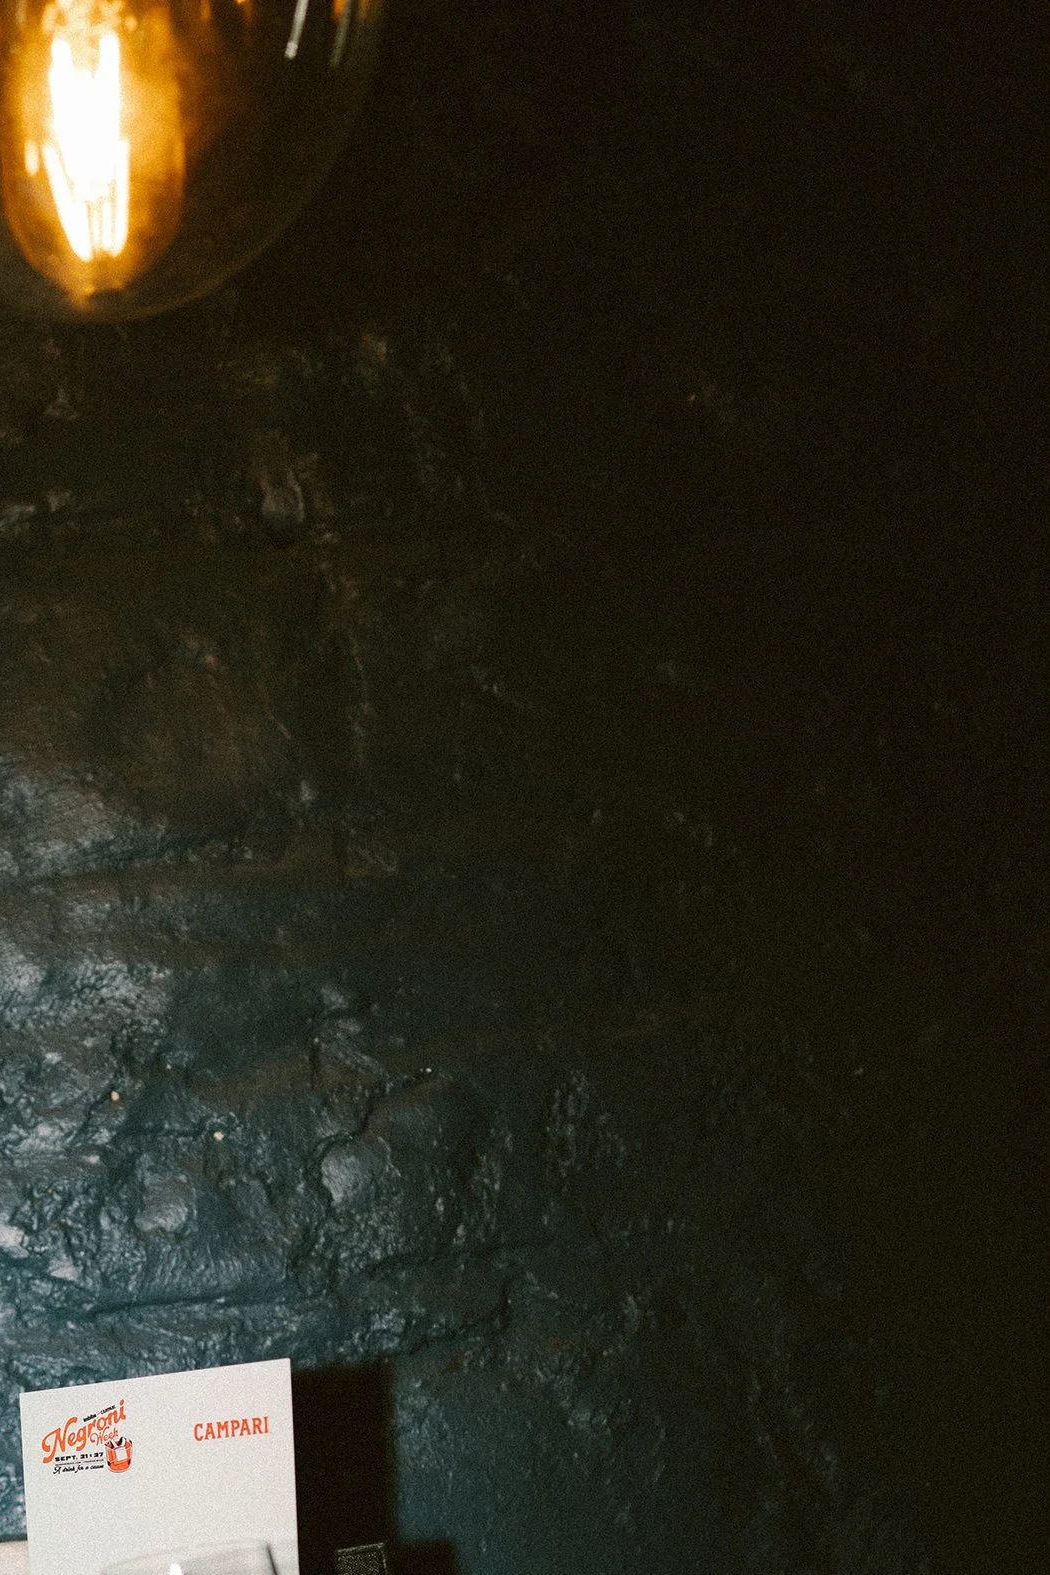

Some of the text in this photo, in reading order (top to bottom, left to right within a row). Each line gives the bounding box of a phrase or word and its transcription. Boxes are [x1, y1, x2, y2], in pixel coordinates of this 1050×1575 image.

[41, 1399, 126, 1464] Negroni
[90, 1426, 119, 1446] Week
[194, 1416, 269, 1442] CAMPARI
